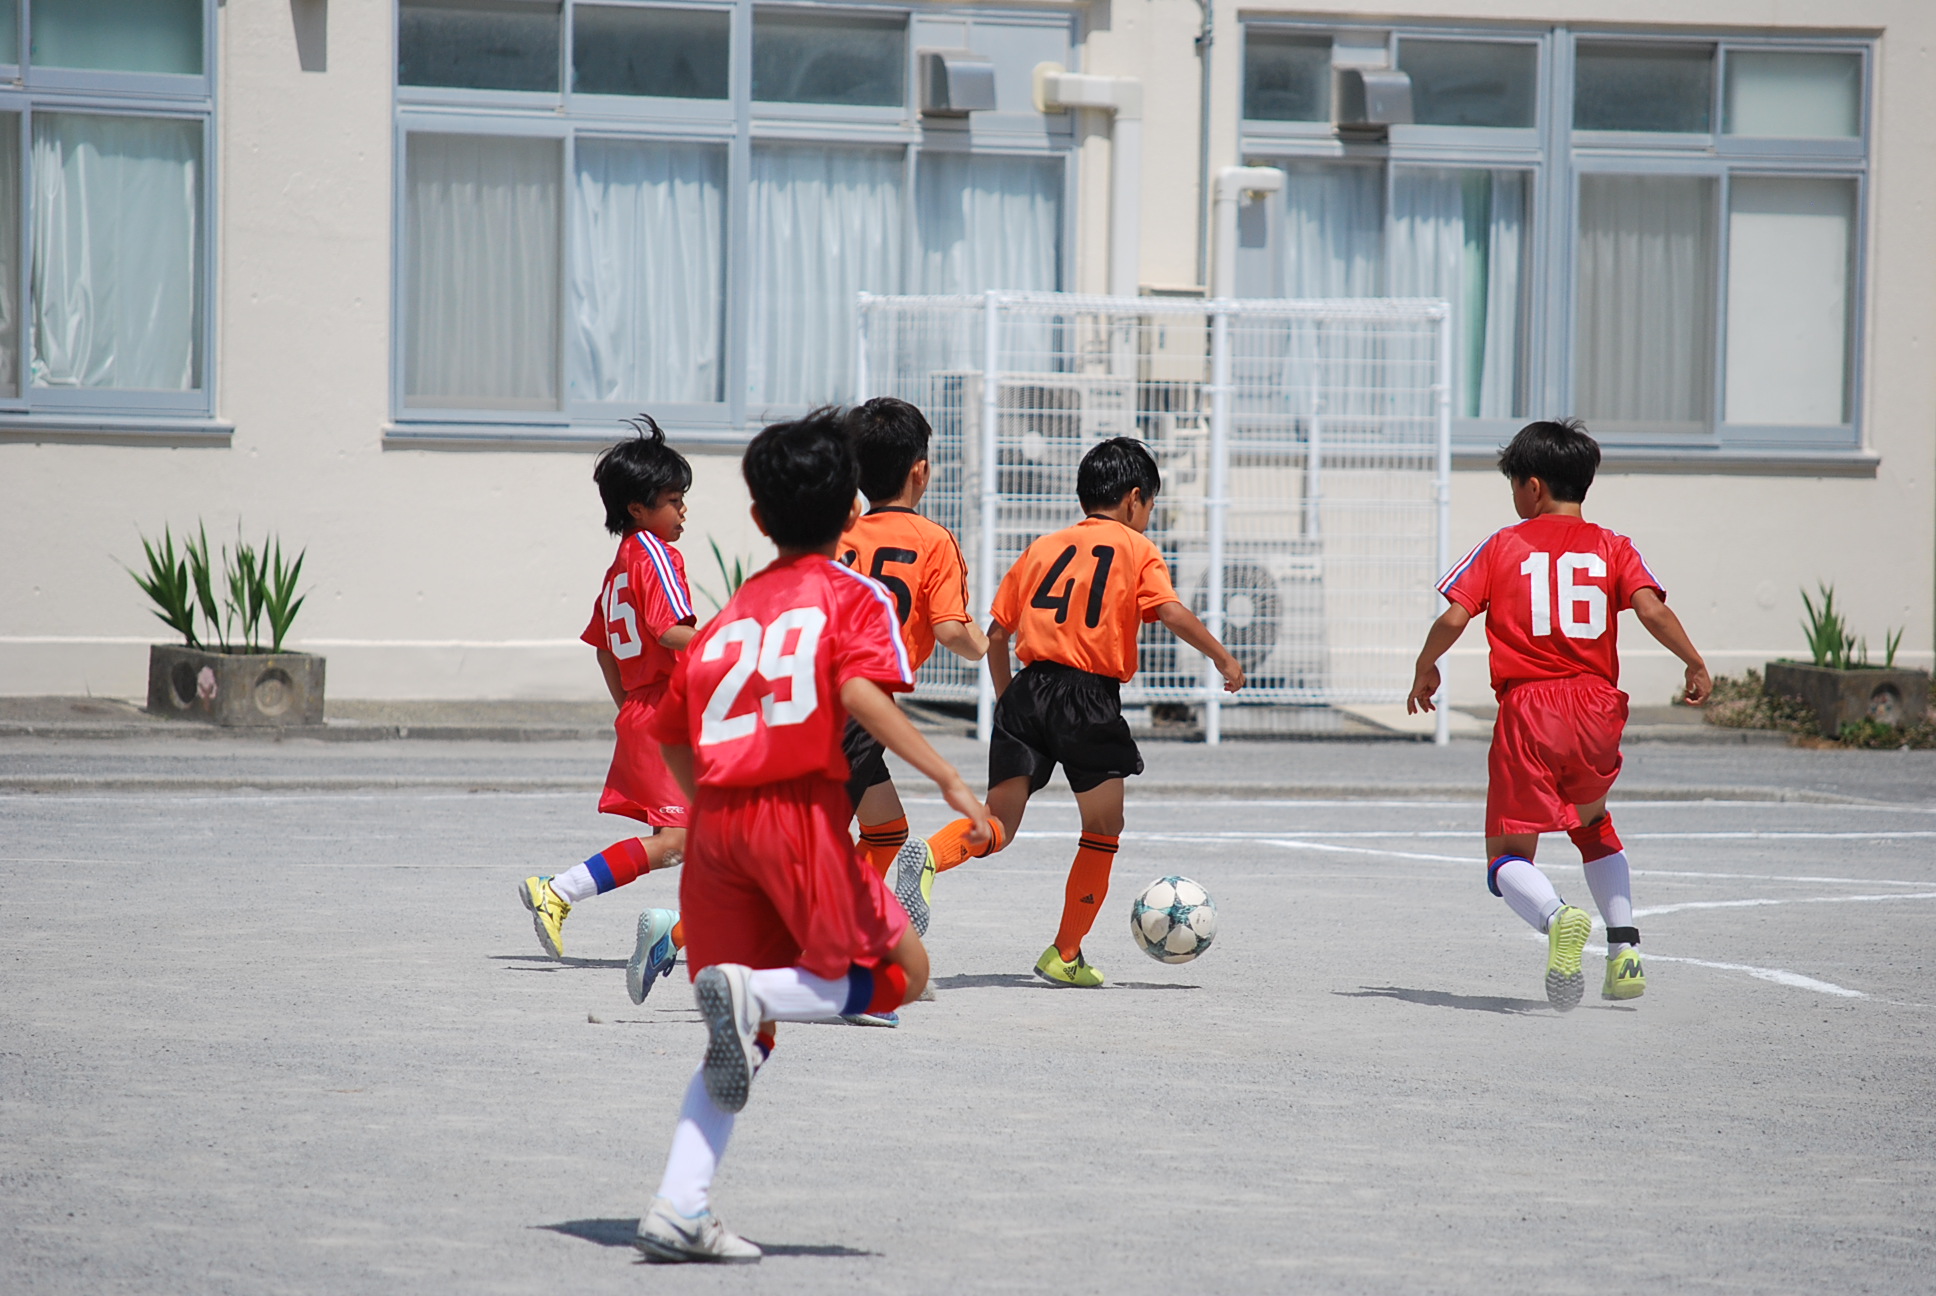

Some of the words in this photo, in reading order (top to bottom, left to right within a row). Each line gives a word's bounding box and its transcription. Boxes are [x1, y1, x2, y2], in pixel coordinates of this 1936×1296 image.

[838, 546, 918, 628] 5
[1030, 544, 1115, 629] 41
[1520, 551, 1608, 640] 16
[698, 605, 828, 746] 29
